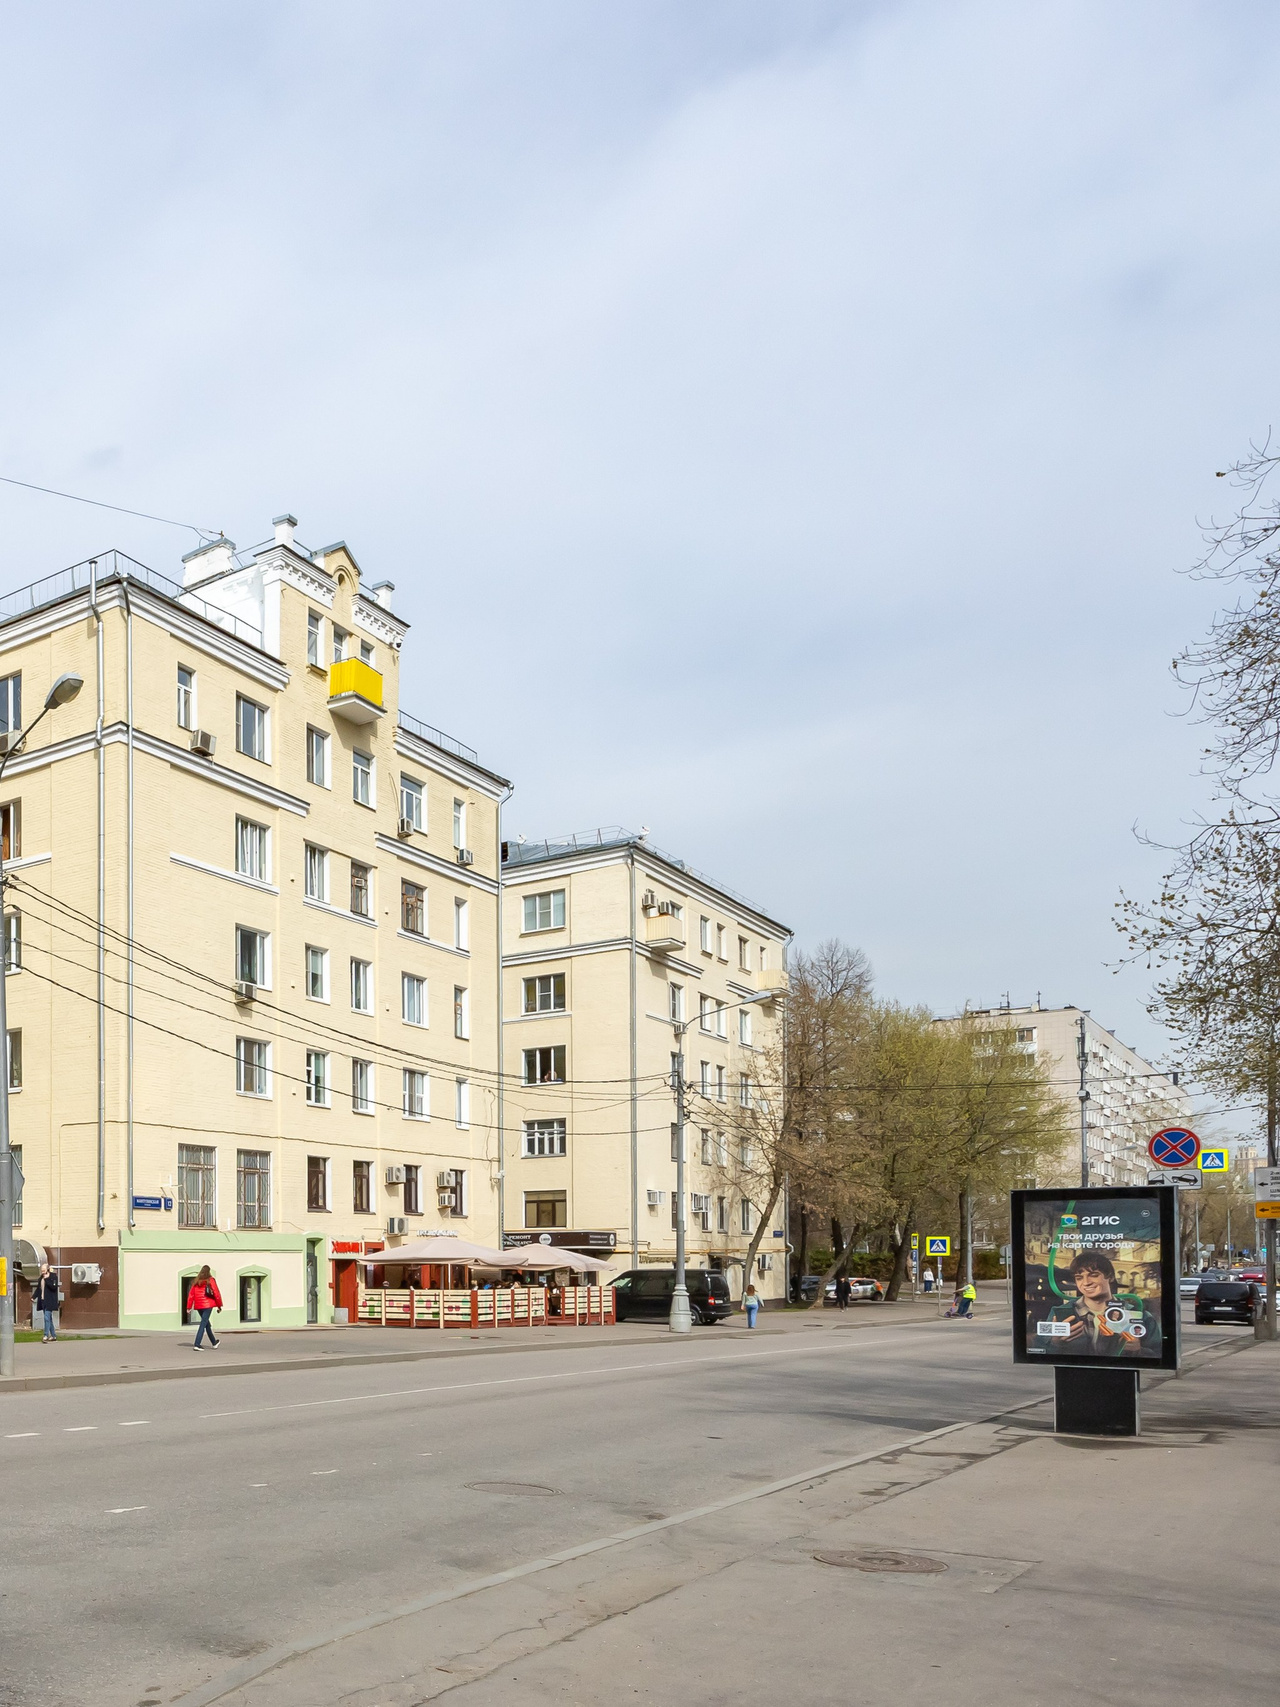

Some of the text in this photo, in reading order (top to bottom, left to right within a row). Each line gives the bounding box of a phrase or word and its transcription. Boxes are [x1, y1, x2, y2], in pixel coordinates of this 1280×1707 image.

[1081, 1216, 1120, 1225] 2ГИС
[1084, 1233, 1124, 1241] друзья
[1062, 1242, 1093, 1250] карте
